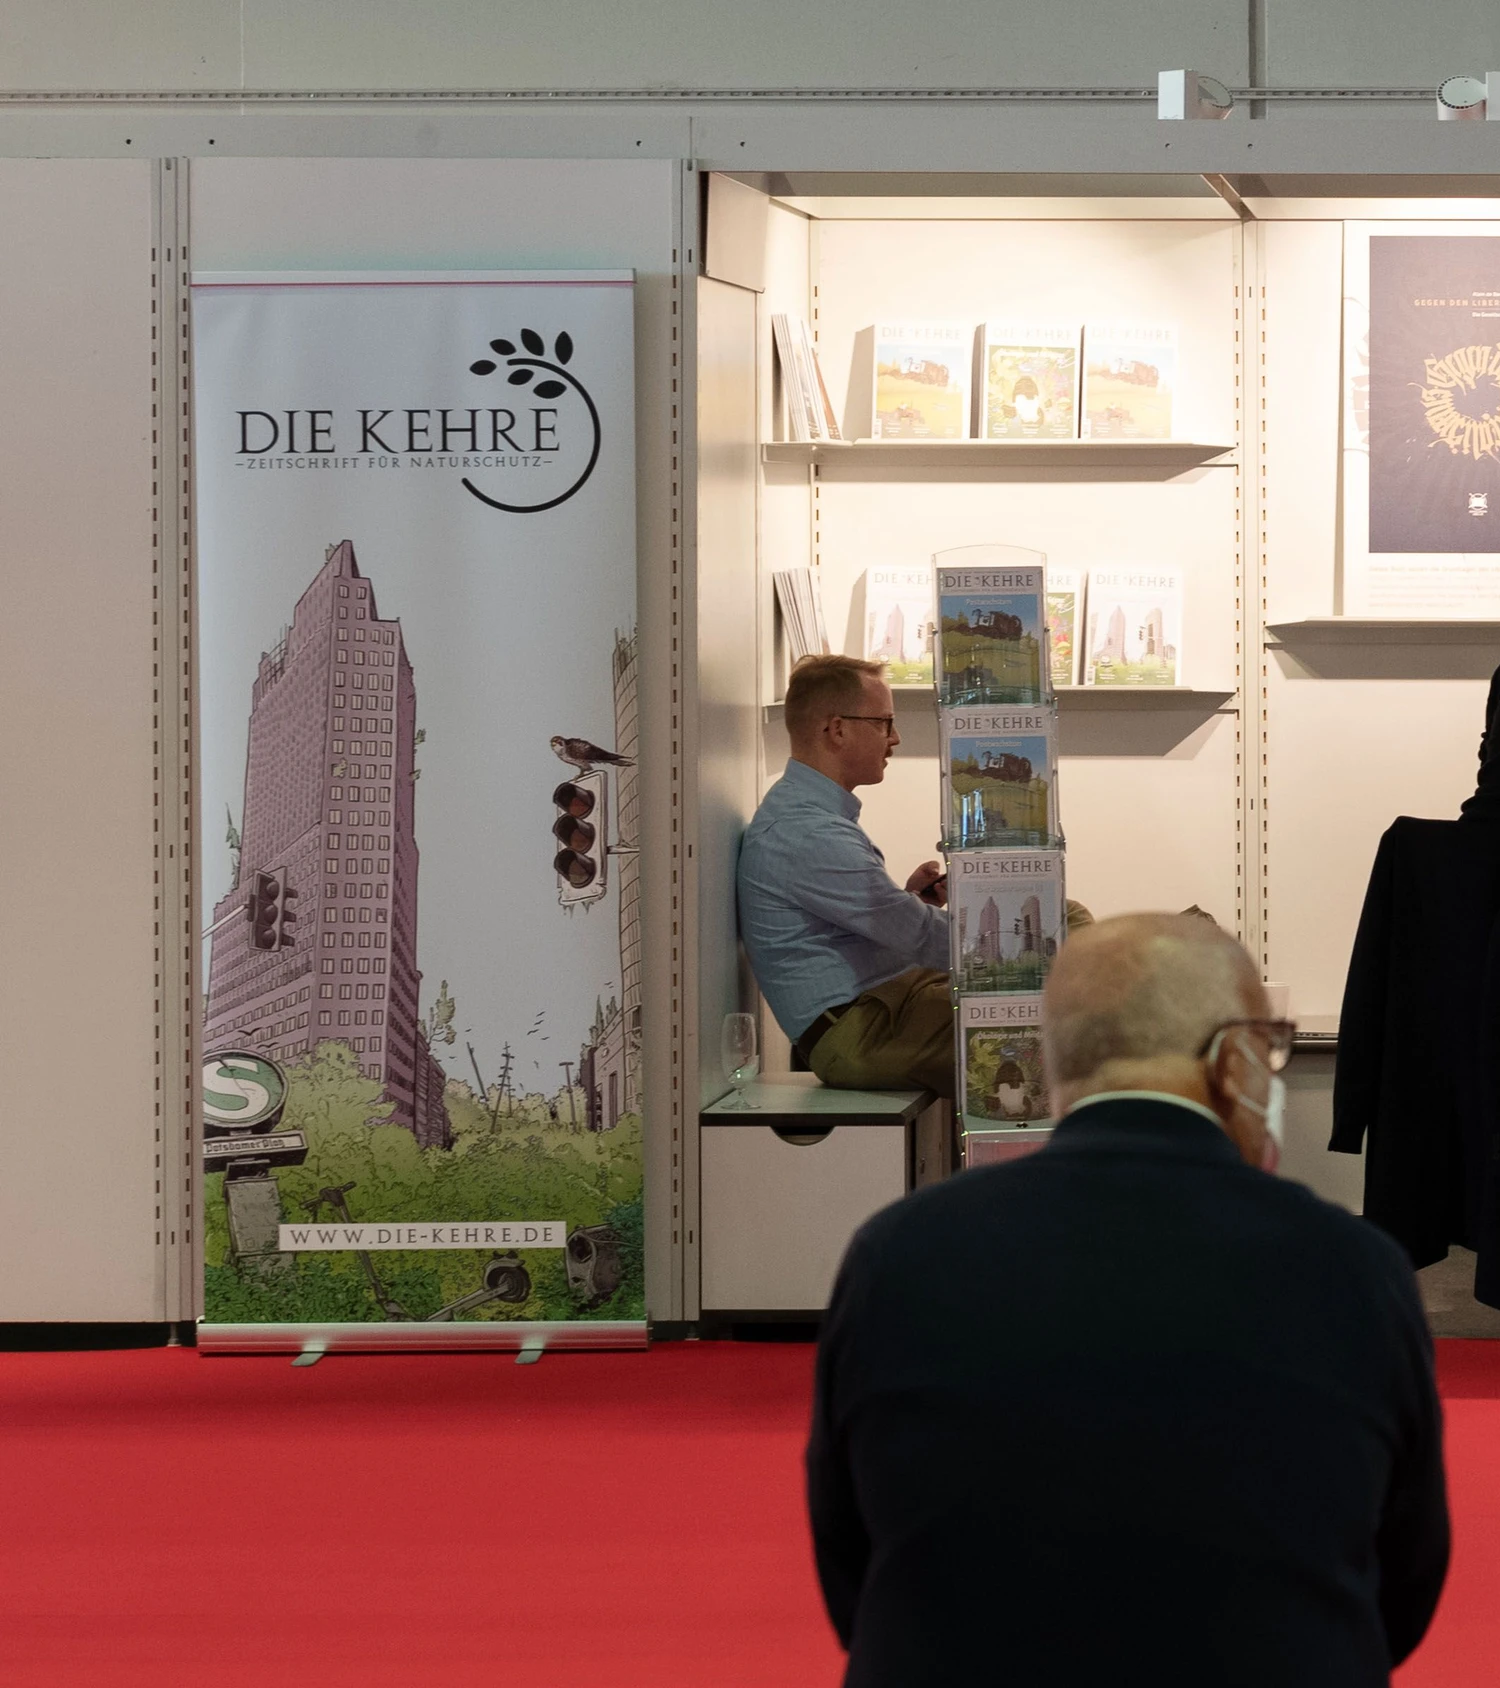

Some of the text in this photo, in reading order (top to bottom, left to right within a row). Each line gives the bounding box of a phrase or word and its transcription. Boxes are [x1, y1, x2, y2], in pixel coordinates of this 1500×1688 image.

[1414, 299, 1446, 307] GEGEN
[1449, 299, 1469, 307] DEN
[235, 408, 561, 455] DIE KEHRE
[368, 455, 401, 471] FÜR
[907, 573, 933, 585] KEH
[945, 574, 1034, 588] DIE KEHRE
[1096, 573, 1176, 588] DIE KEHRE
[955, 716, 1043, 730] DIE KEHRE
[963, 860, 1052, 874] DIE KEHRE
[970, 1005, 1039, 1019] DIE KEH
[290, 1227, 554, 1245] WWW.DIE-KEHRE.DE
